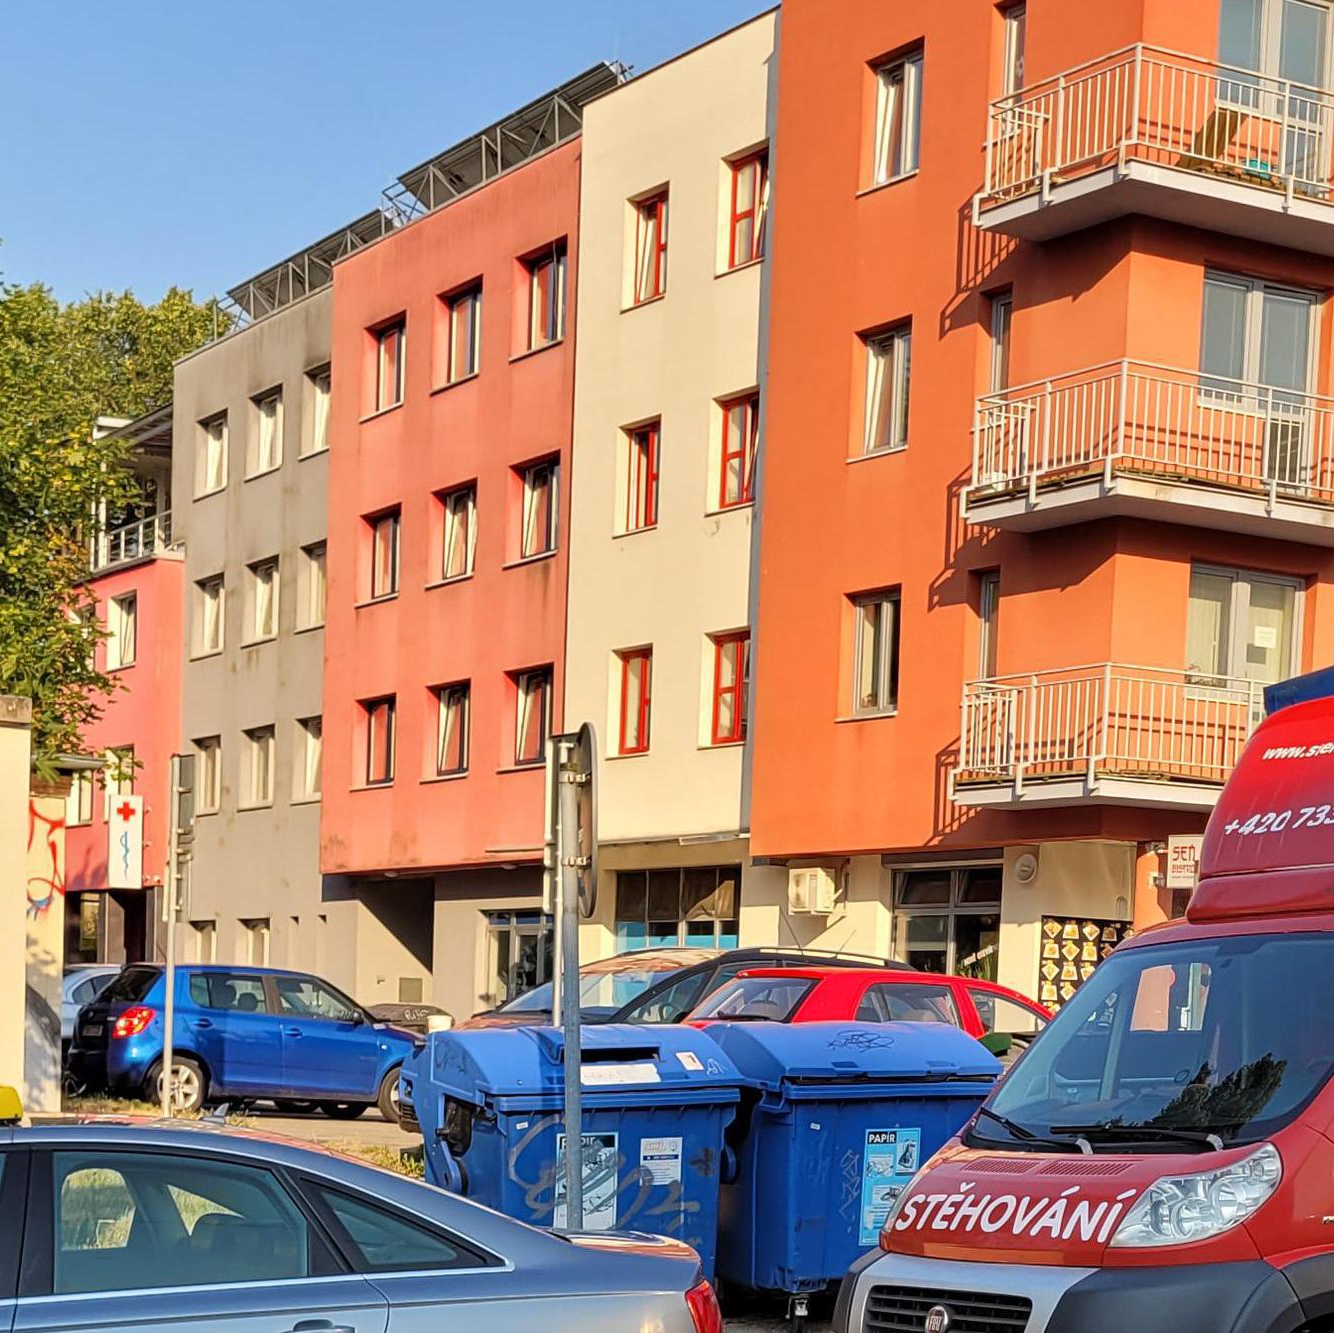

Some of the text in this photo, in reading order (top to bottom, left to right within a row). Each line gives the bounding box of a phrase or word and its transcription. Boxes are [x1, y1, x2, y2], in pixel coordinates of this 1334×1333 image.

[1223, 810, 1292, 836] +420
[868, 1131, 896, 1143] PAPÍR
[895, 1182, 1137, 1243] STĚHOVÁNÍ
